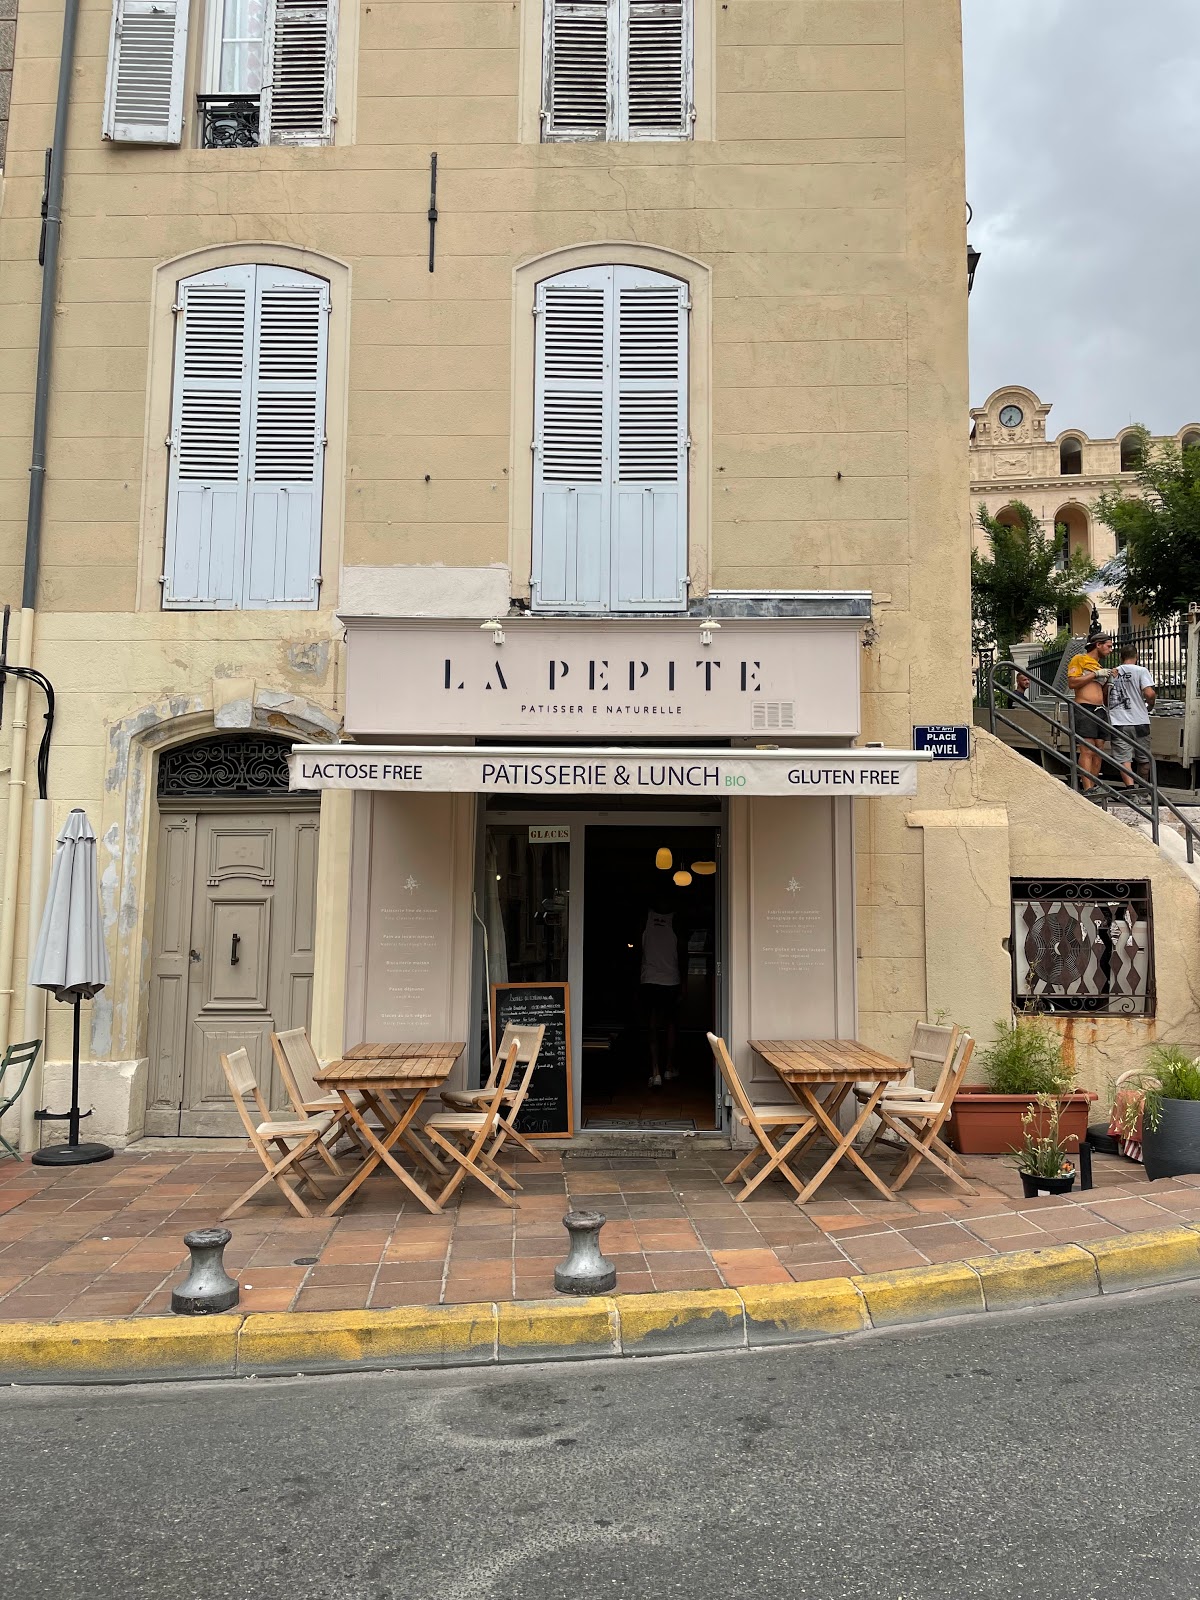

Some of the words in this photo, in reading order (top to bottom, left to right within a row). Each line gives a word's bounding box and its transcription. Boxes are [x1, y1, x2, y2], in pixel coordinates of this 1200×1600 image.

[444, 659, 508, 690] LA
[549, 660, 761, 691] PEPITE
[606, 705, 682, 714] NATURELLE
[926, 733, 957, 741] PLACE
[923, 744, 959, 754] DAVIEL
[302, 763, 378, 779] LACTOSE
[383, 765, 422, 780] FREE
[482, 764, 607, 785] PATISSERIE
[613, 765, 631, 786] &
[637, 766, 719, 786] LUNCH
[725, 776, 747, 787] BIO
[787, 769, 855, 785] GLUTEN
[860, 770, 900, 785] FREE
[530, 830, 569, 839] GLACES
